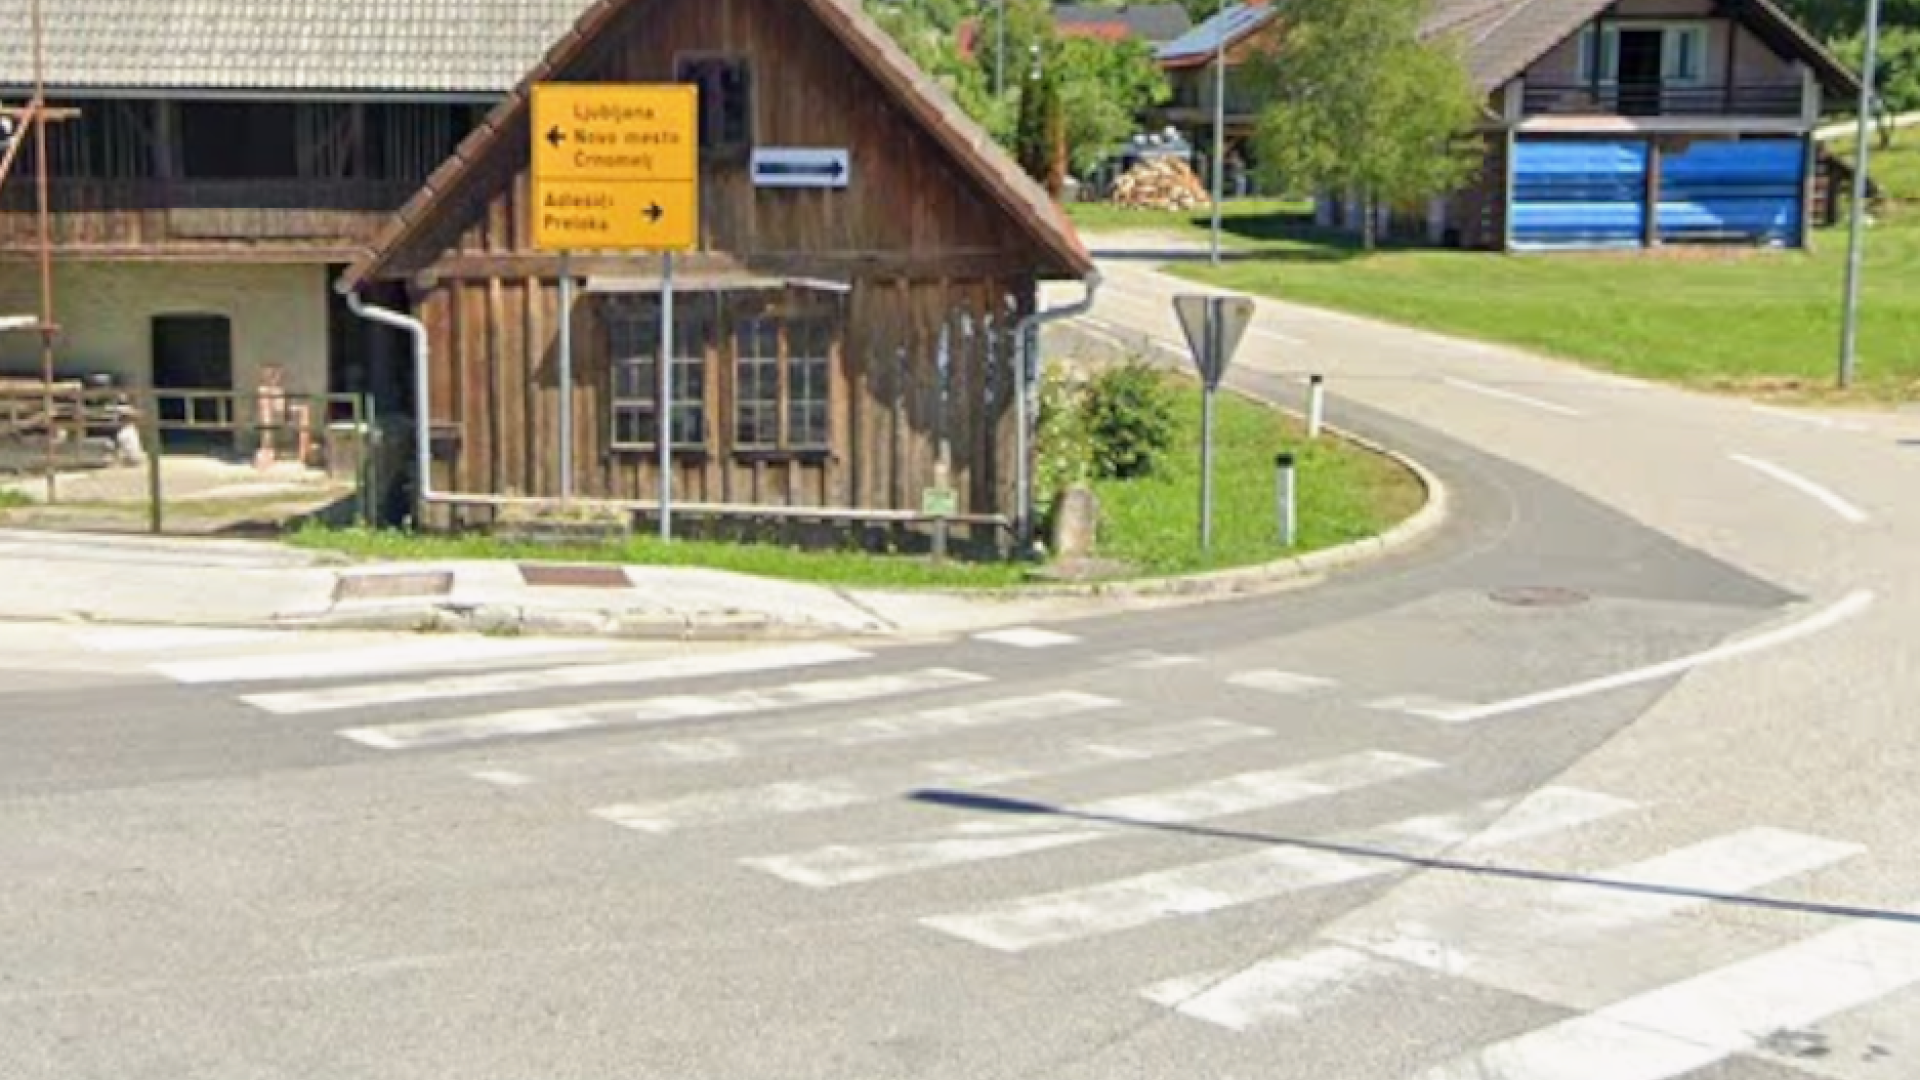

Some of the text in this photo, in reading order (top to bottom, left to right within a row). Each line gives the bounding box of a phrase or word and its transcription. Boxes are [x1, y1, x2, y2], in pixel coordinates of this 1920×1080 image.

[573, 103, 655, 123] Ljubljana
[573, 129, 680, 145] Novo mesto
